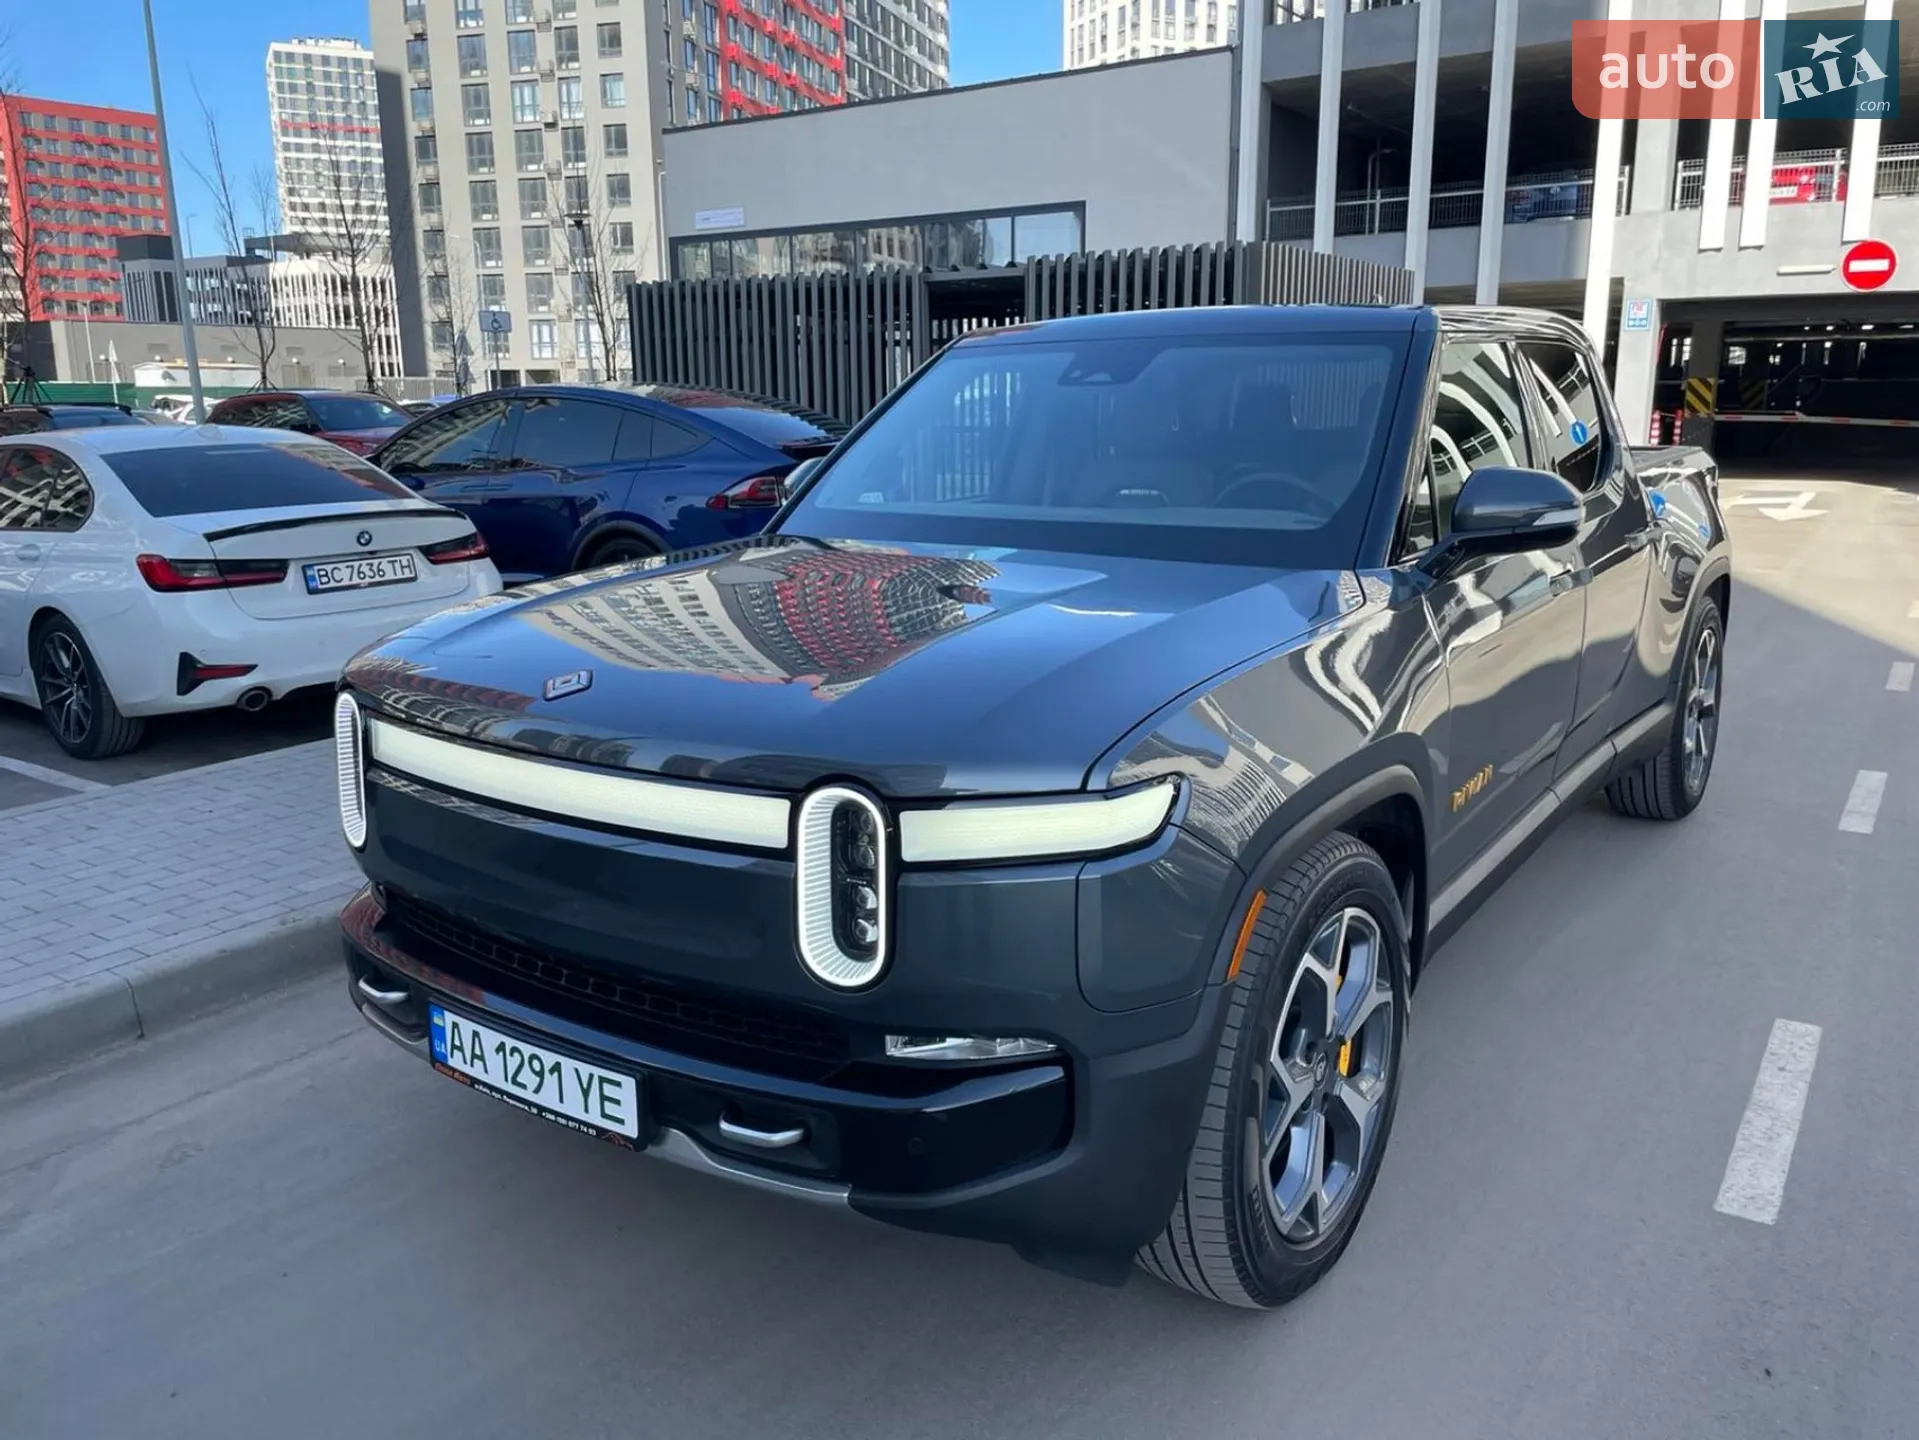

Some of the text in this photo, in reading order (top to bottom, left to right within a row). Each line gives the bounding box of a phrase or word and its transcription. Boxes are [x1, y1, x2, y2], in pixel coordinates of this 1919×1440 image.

[317, 558, 413, 585] BC 7636 TH
[450, 1020, 489, 1075] AA
[494, 1041, 564, 1105] 1291
[573, 1067, 626, 1126] YE
